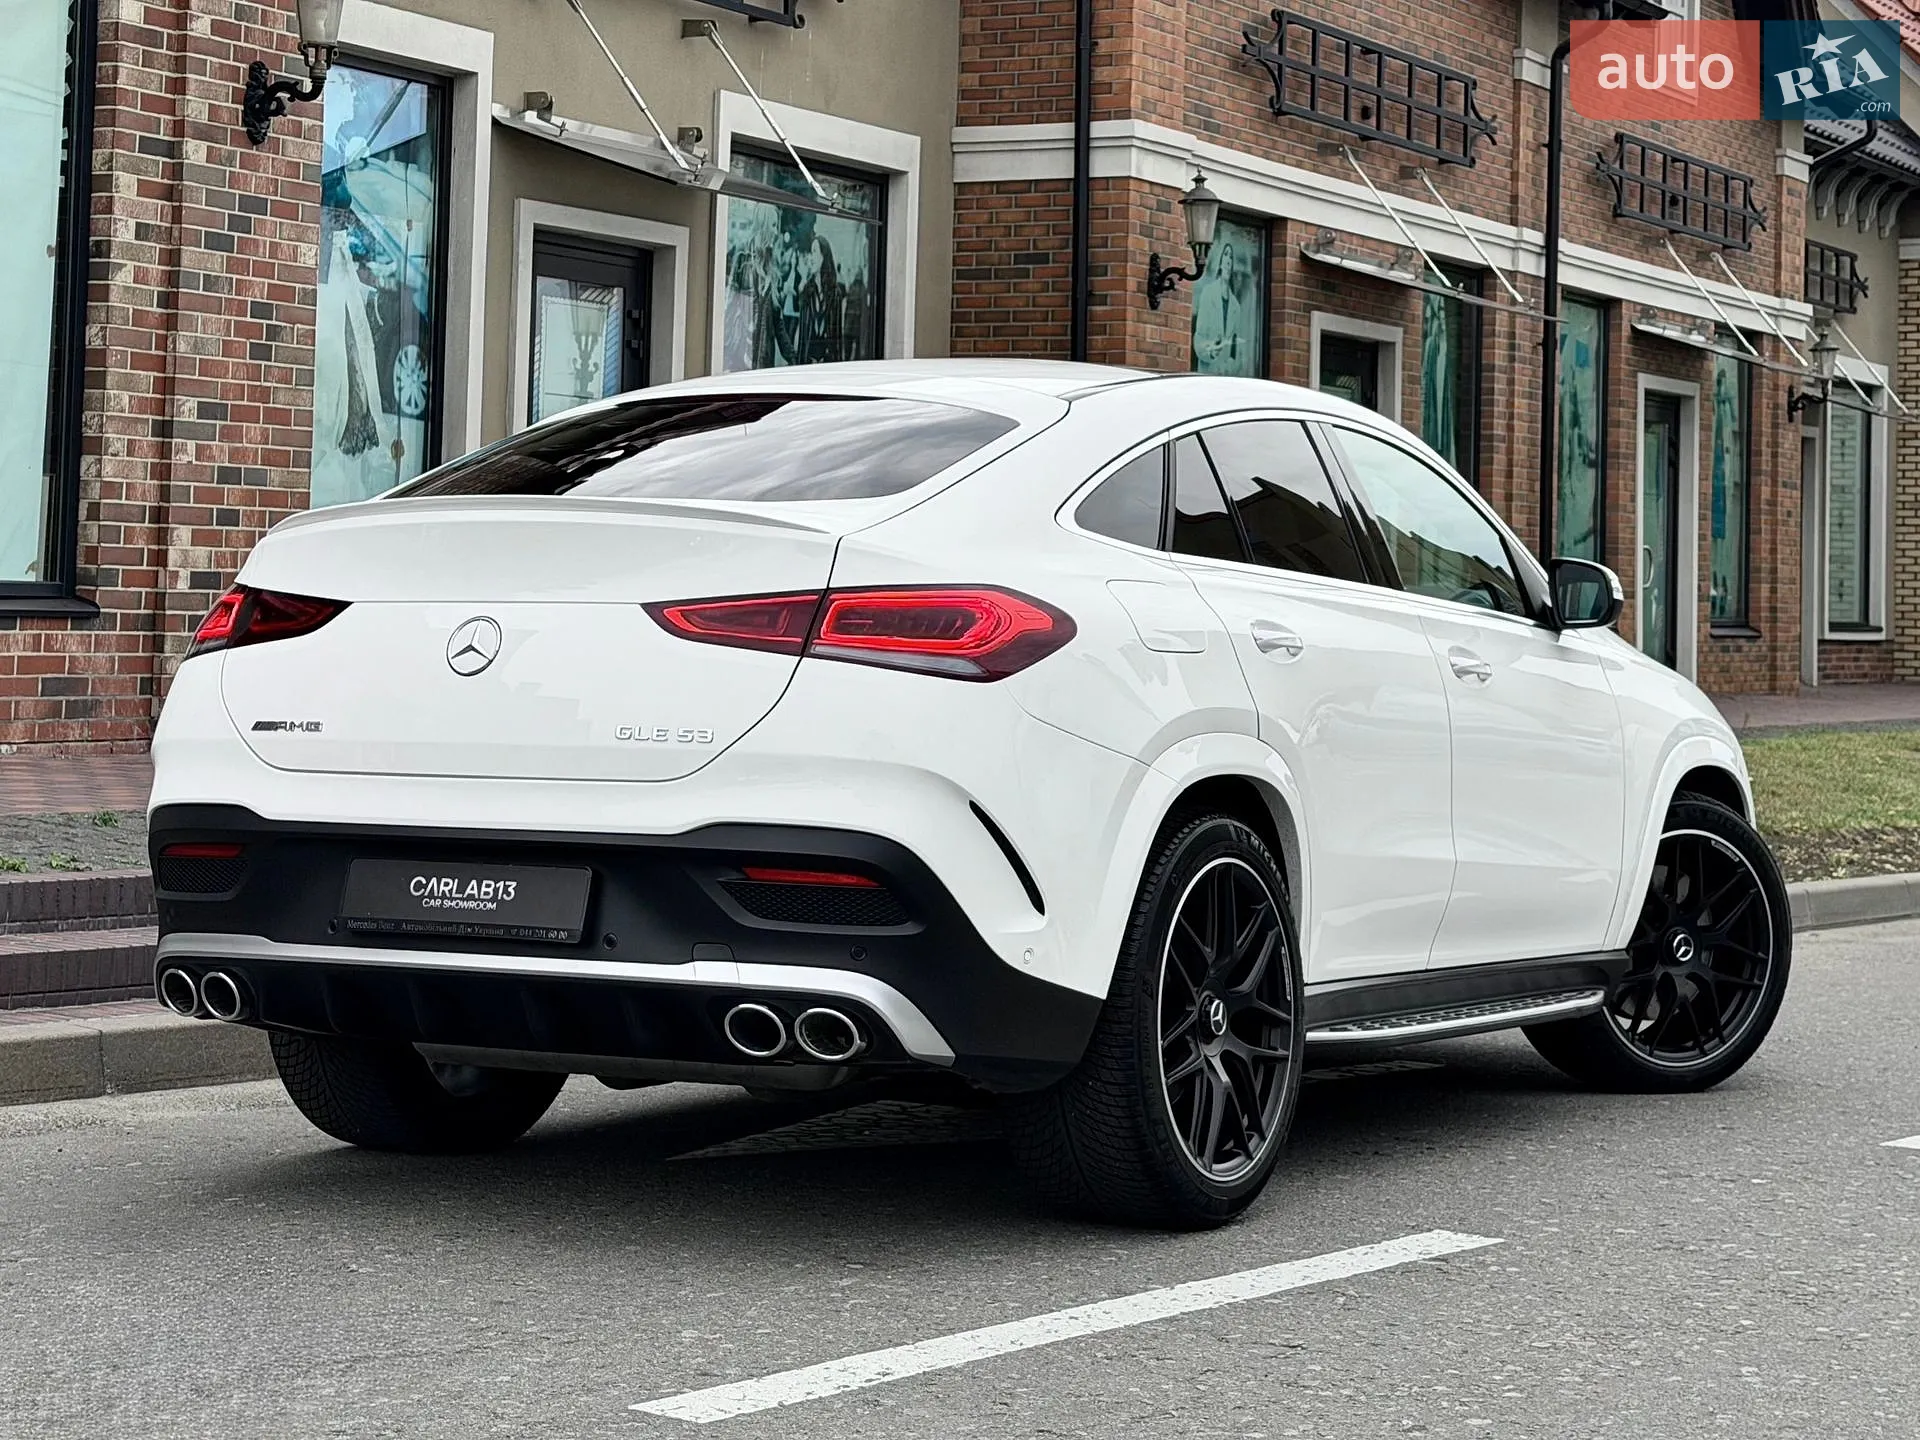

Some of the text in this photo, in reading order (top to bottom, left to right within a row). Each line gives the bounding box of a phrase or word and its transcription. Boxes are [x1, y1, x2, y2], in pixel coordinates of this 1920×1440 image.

[615, 725, 714, 743] GLE 53
[409, 876, 517, 900] CARLAB13
[422, 898, 497, 910] CAR SHOWROOM
